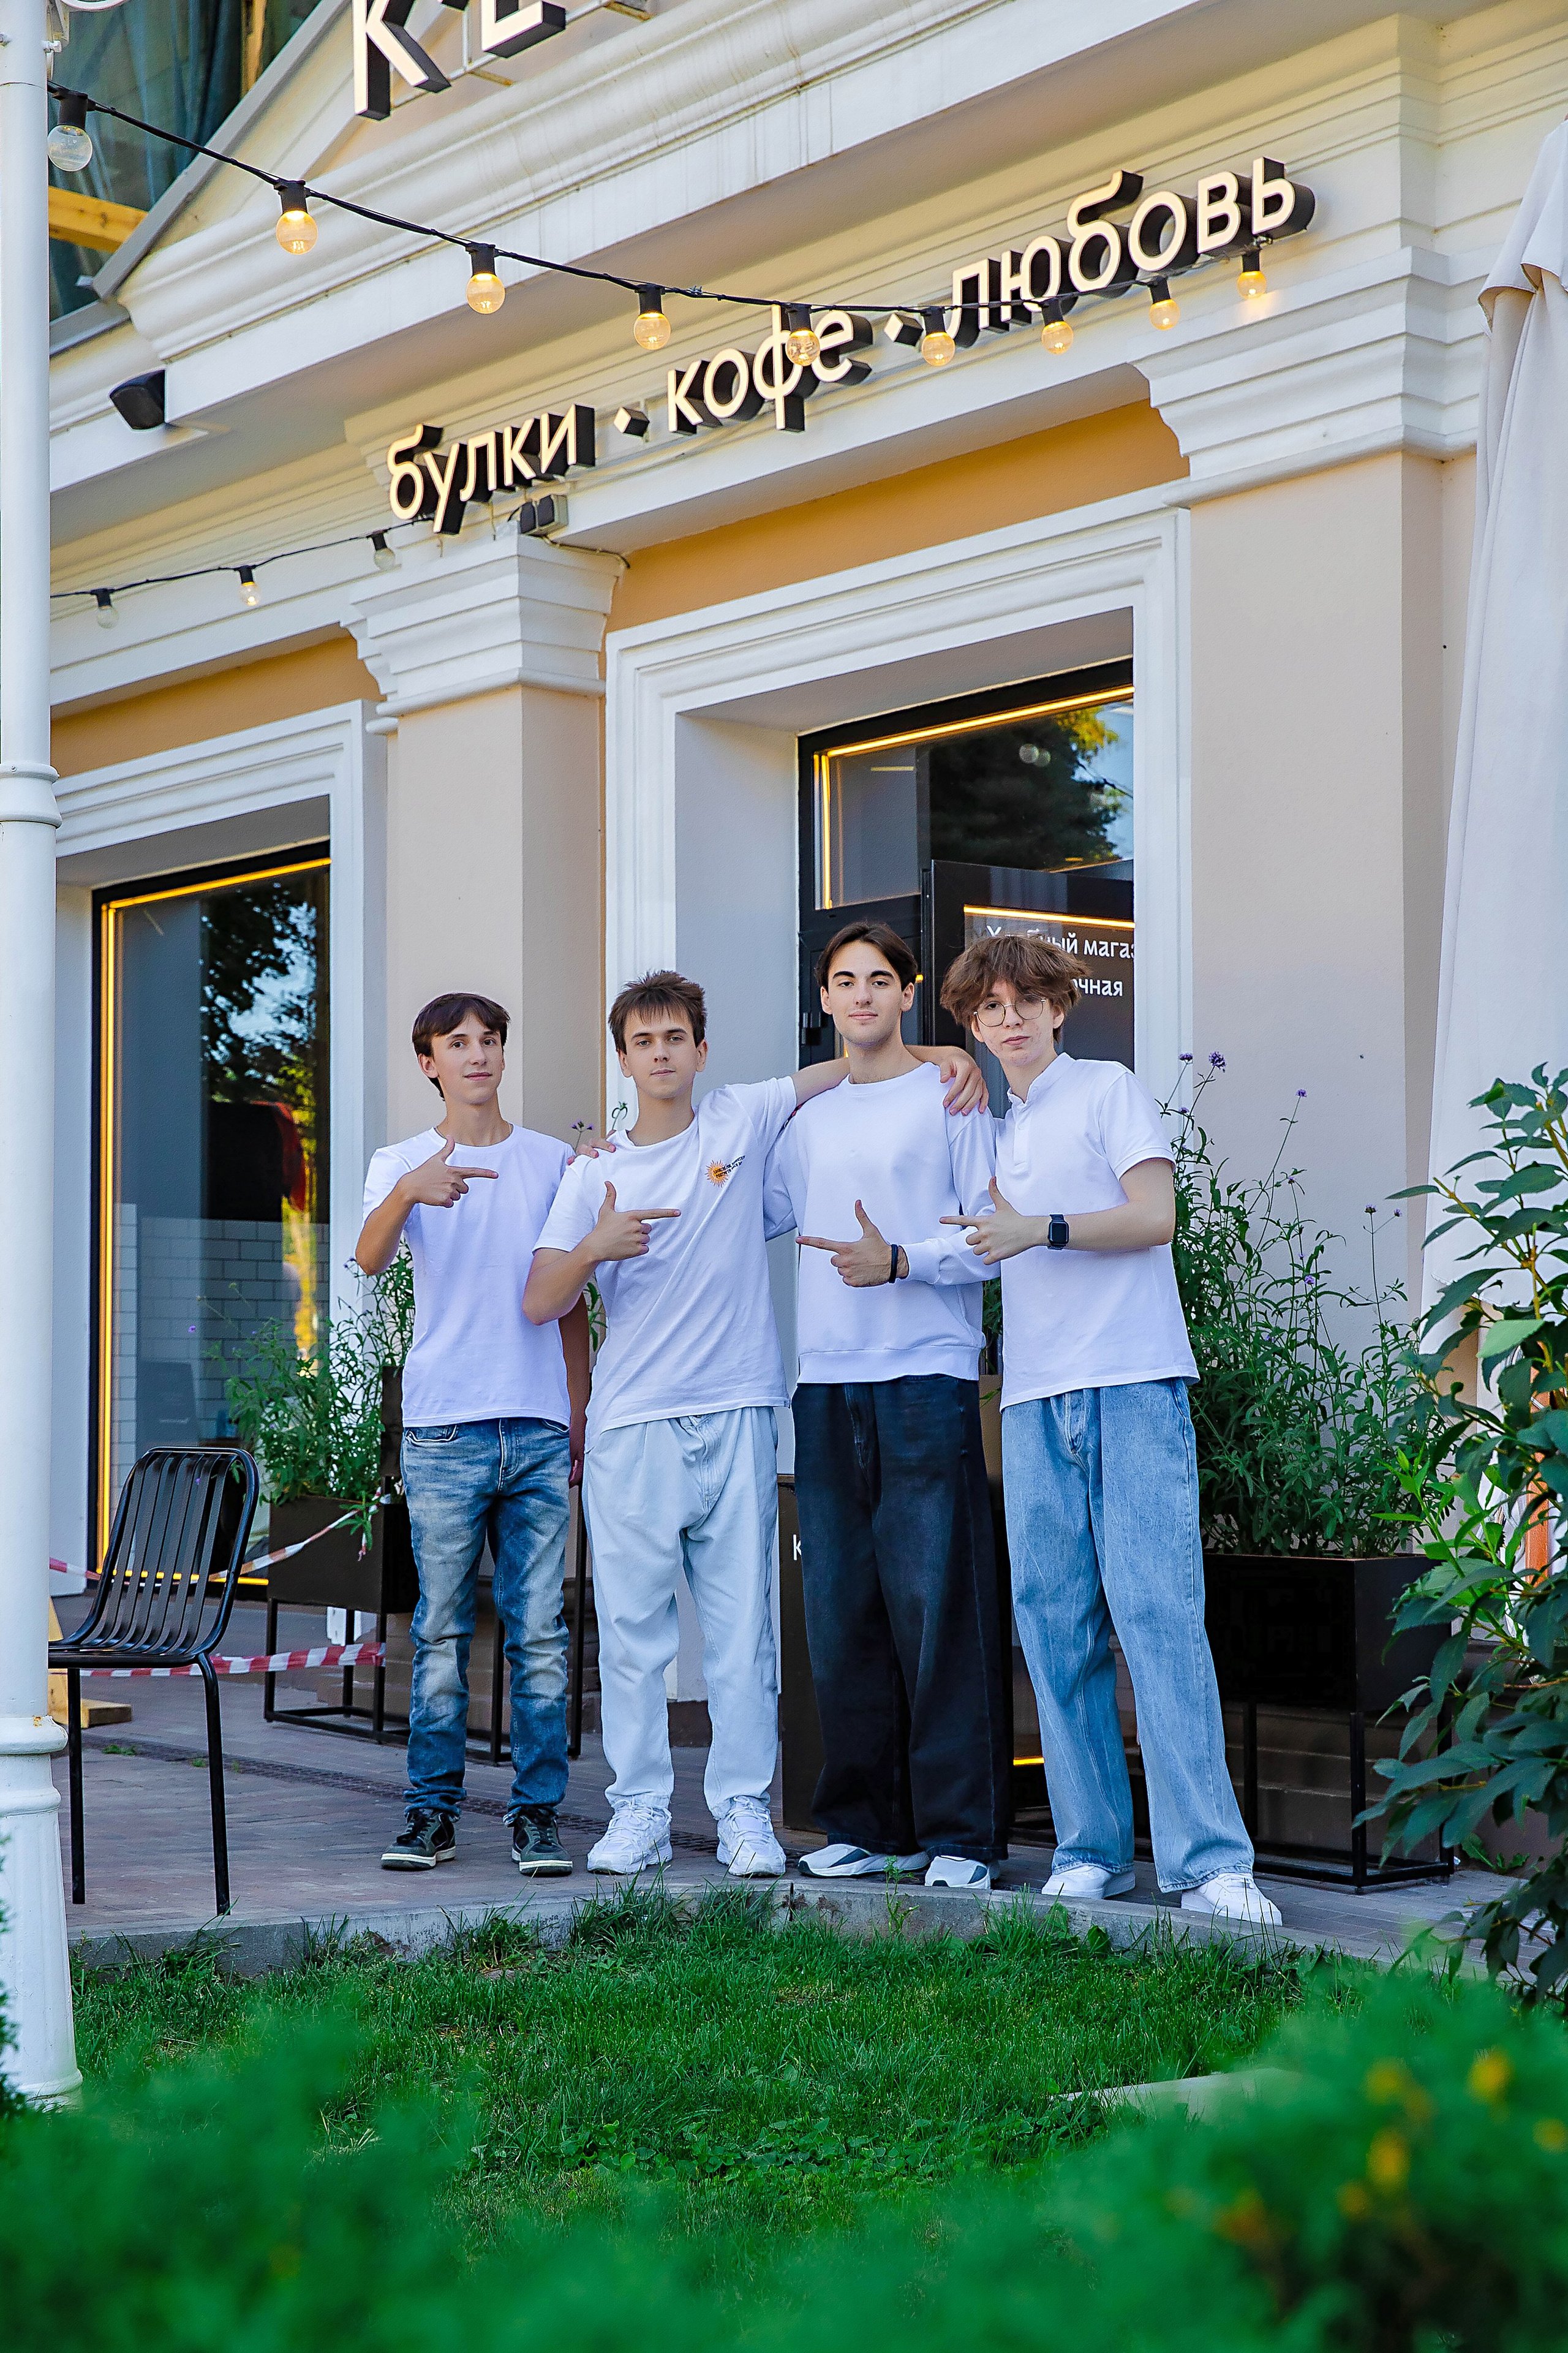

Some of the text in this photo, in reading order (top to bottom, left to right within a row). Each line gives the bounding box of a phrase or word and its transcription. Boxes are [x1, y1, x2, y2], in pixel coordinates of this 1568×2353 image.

[386, 157, 1311, 534] булки кофе любовь
